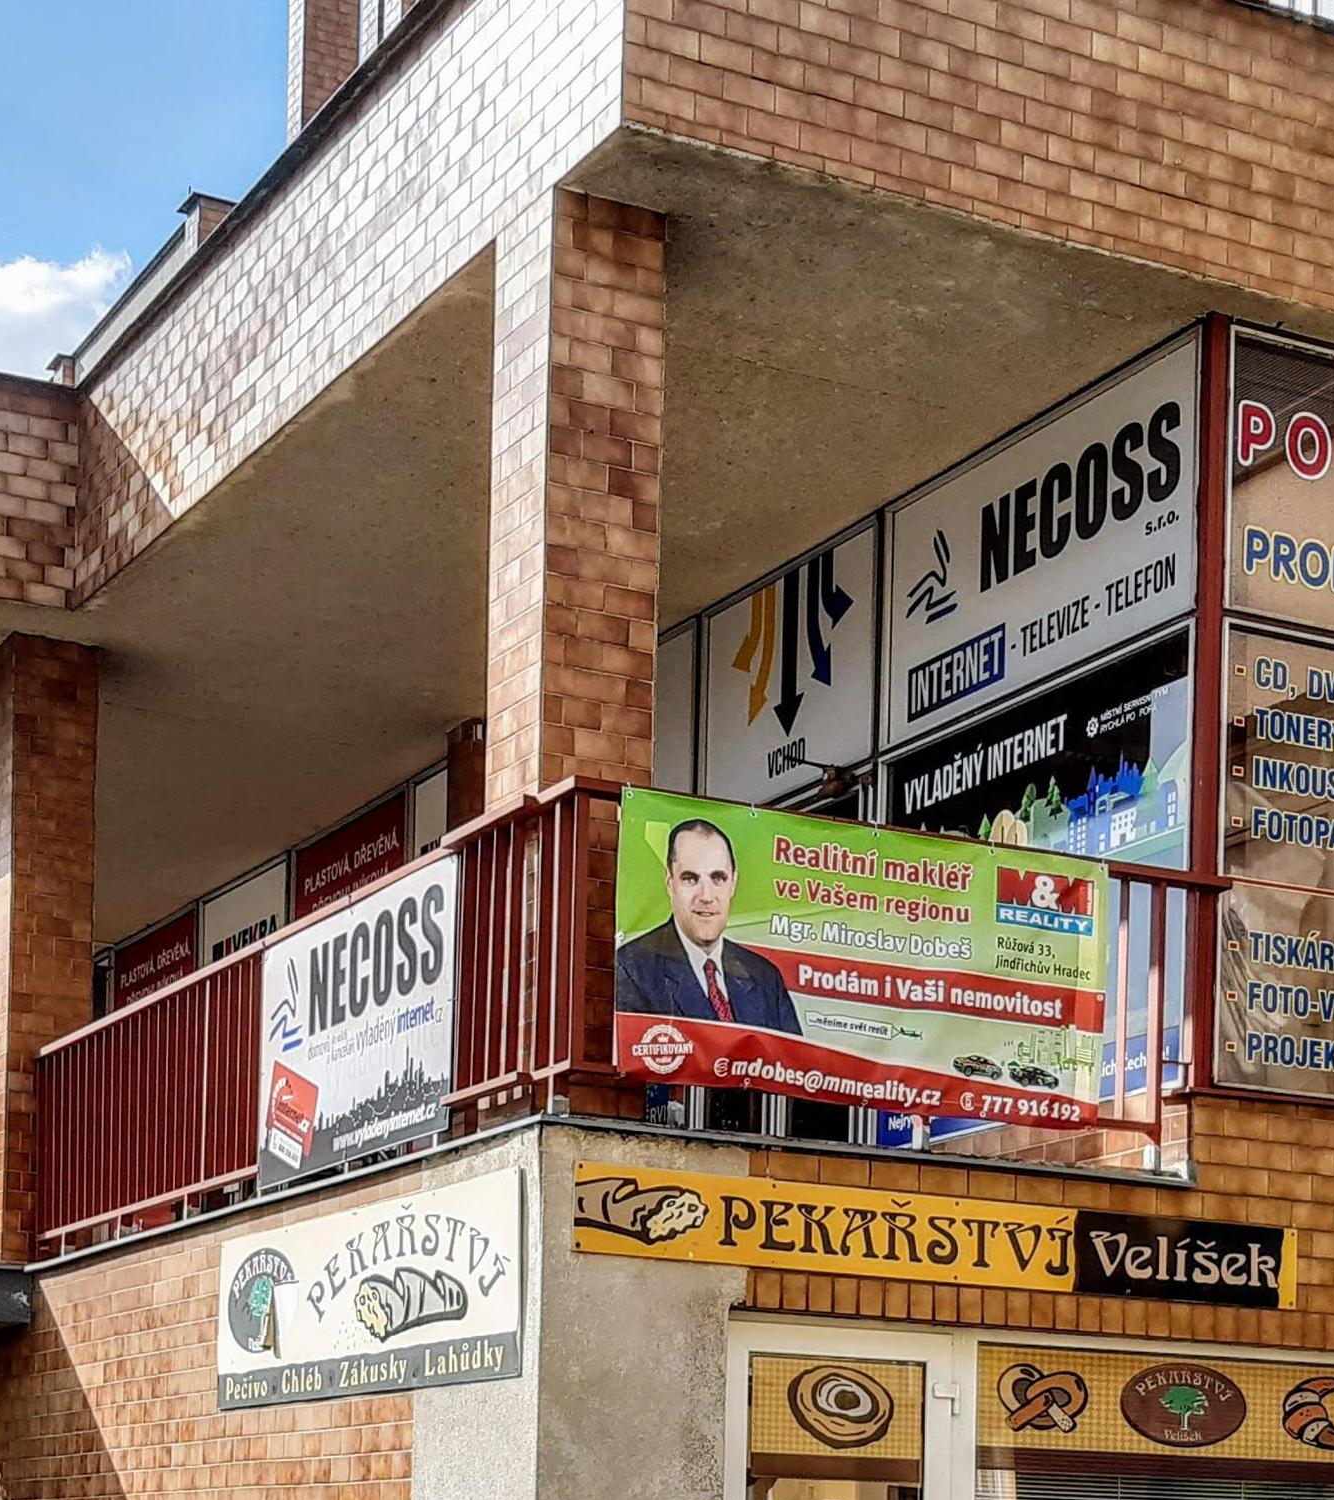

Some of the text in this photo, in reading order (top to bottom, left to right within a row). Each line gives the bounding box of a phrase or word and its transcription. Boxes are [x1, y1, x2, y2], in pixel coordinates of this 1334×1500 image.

[979, 401, 1181, 593] NECOSS
[1145, 511, 1180, 537] s.r.o.
[910, 553, 1177, 716] INTERNET TELEVIZE TELEFON
[1254, 656, 1297, 699] CD,
[767, 737, 806, 780] VCHOD
[904, 713, 1068, 815] VYLADĚNÝ INTERNET
[304, 853, 352, 896] PLASTOVÁ,
[353, 826, 400, 869] DŘEVĚNÁ,
[773, 835, 974, 891] Realitní makléř
[774, 879, 971, 924] ve Vašem regionu
[997, 866, 1095, 916] M&M
[770, 914, 972, 959] Mgr. Miroslav Dobeš
[998, 907, 1089, 932] REALITY
[120, 962, 156, 989] PLASTOVÁ,
[156, 936, 191, 969] DŘEVĚNÁ,
[308, 884, 445, 1037] NECOSS
[995, 954, 1091, 980] Jindřichův Hradec
[997, 936, 1056, 959] Růžová 33,
[798, 964, 1063, 1020] Prodám i Vaši nemovitost
[632, 1040, 694, 1057] CERTIFIKOVANÝ
[849, 1020, 867, 1032] svět
[731, 1057, 1081, 1122] mdobes@mmreality.cz 777 916 192
[307, 1203, 512, 1323] PEKAŘSTVÍ
[716, 1197, 1280, 1290] PEKAŘSTVÍ Velíšek
[225, 1342, 505, 1402] Pečivo Chléb Zákusky Lahůdky
